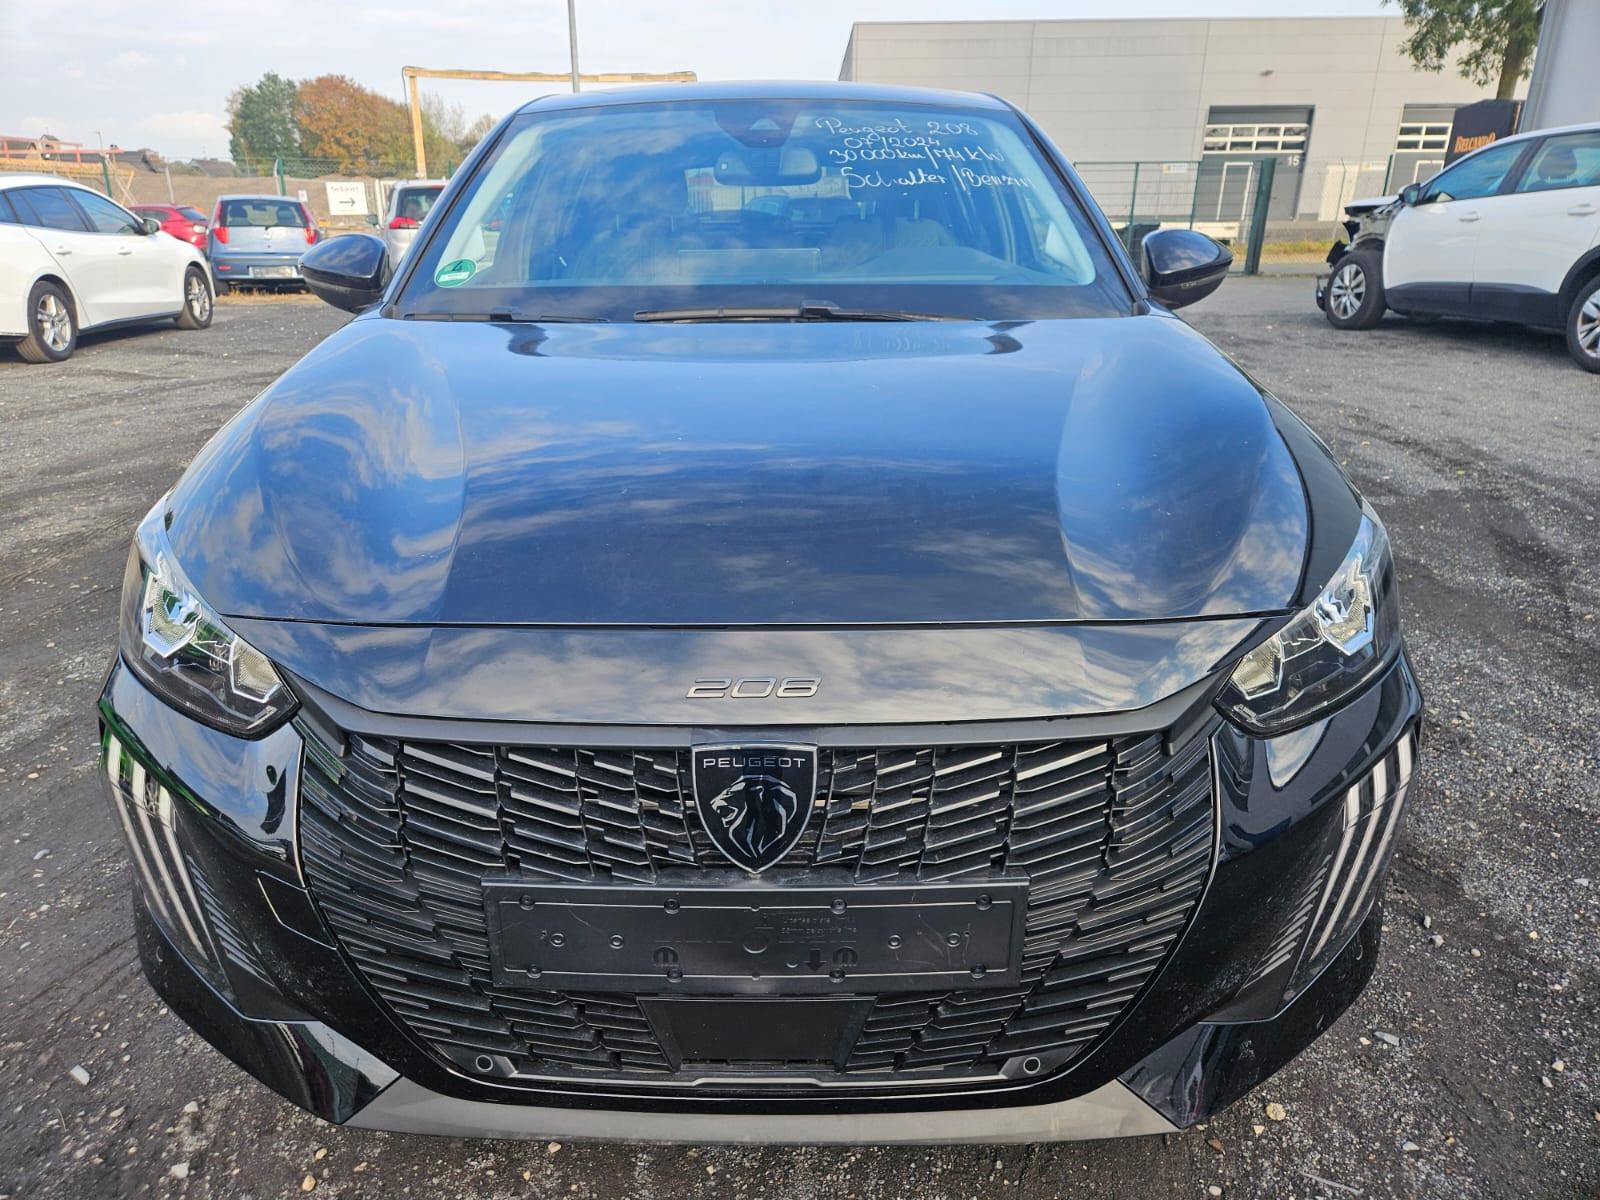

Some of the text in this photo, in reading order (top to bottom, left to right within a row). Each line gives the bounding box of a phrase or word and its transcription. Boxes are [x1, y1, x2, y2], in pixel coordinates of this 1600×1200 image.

[817, 117, 979, 139] Peugeot 208
[1287, 155, 1300, 166] 15
[686, 677, 822, 698] 208
[703, 757, 806, 769] PEUGEOT
